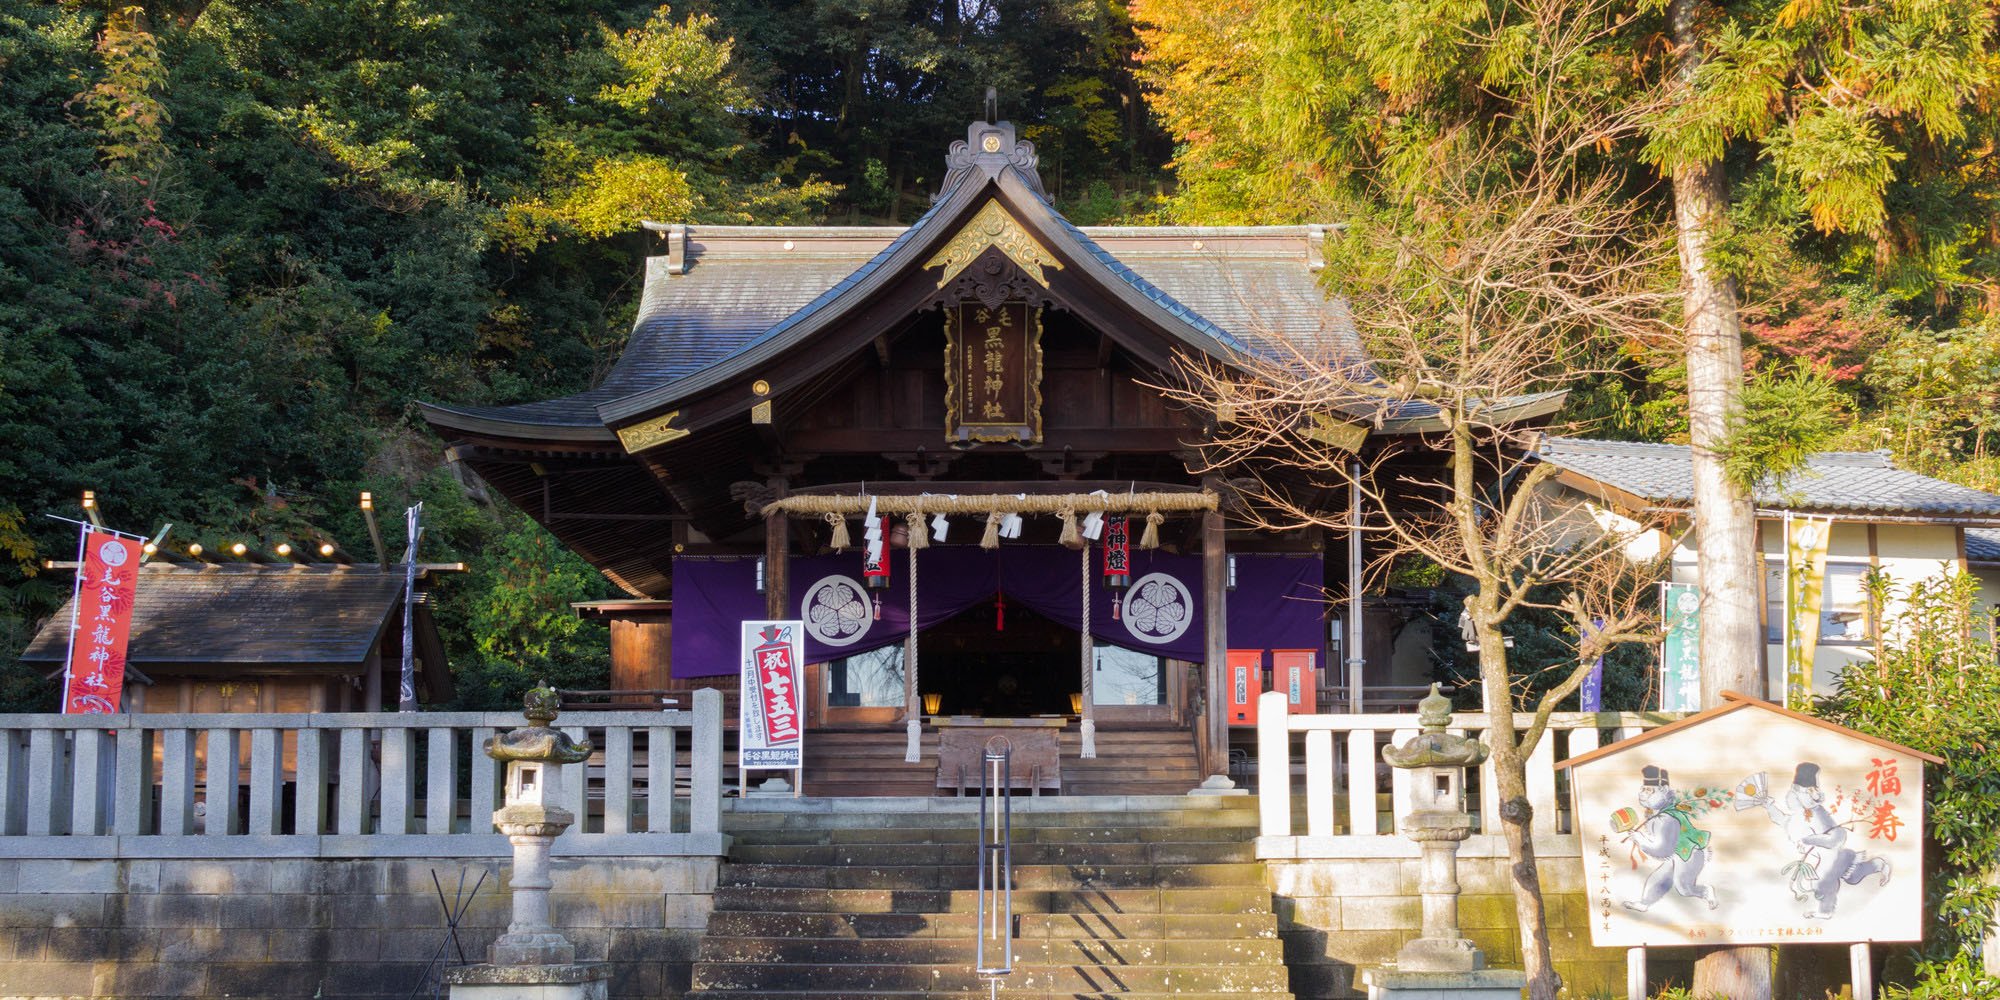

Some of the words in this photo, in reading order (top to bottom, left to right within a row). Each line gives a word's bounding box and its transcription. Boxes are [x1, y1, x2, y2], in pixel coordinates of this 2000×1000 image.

[84, 566, 121, 689] 毛谷黒龍神社
[1865, 758, 1905, 842] 福寿
